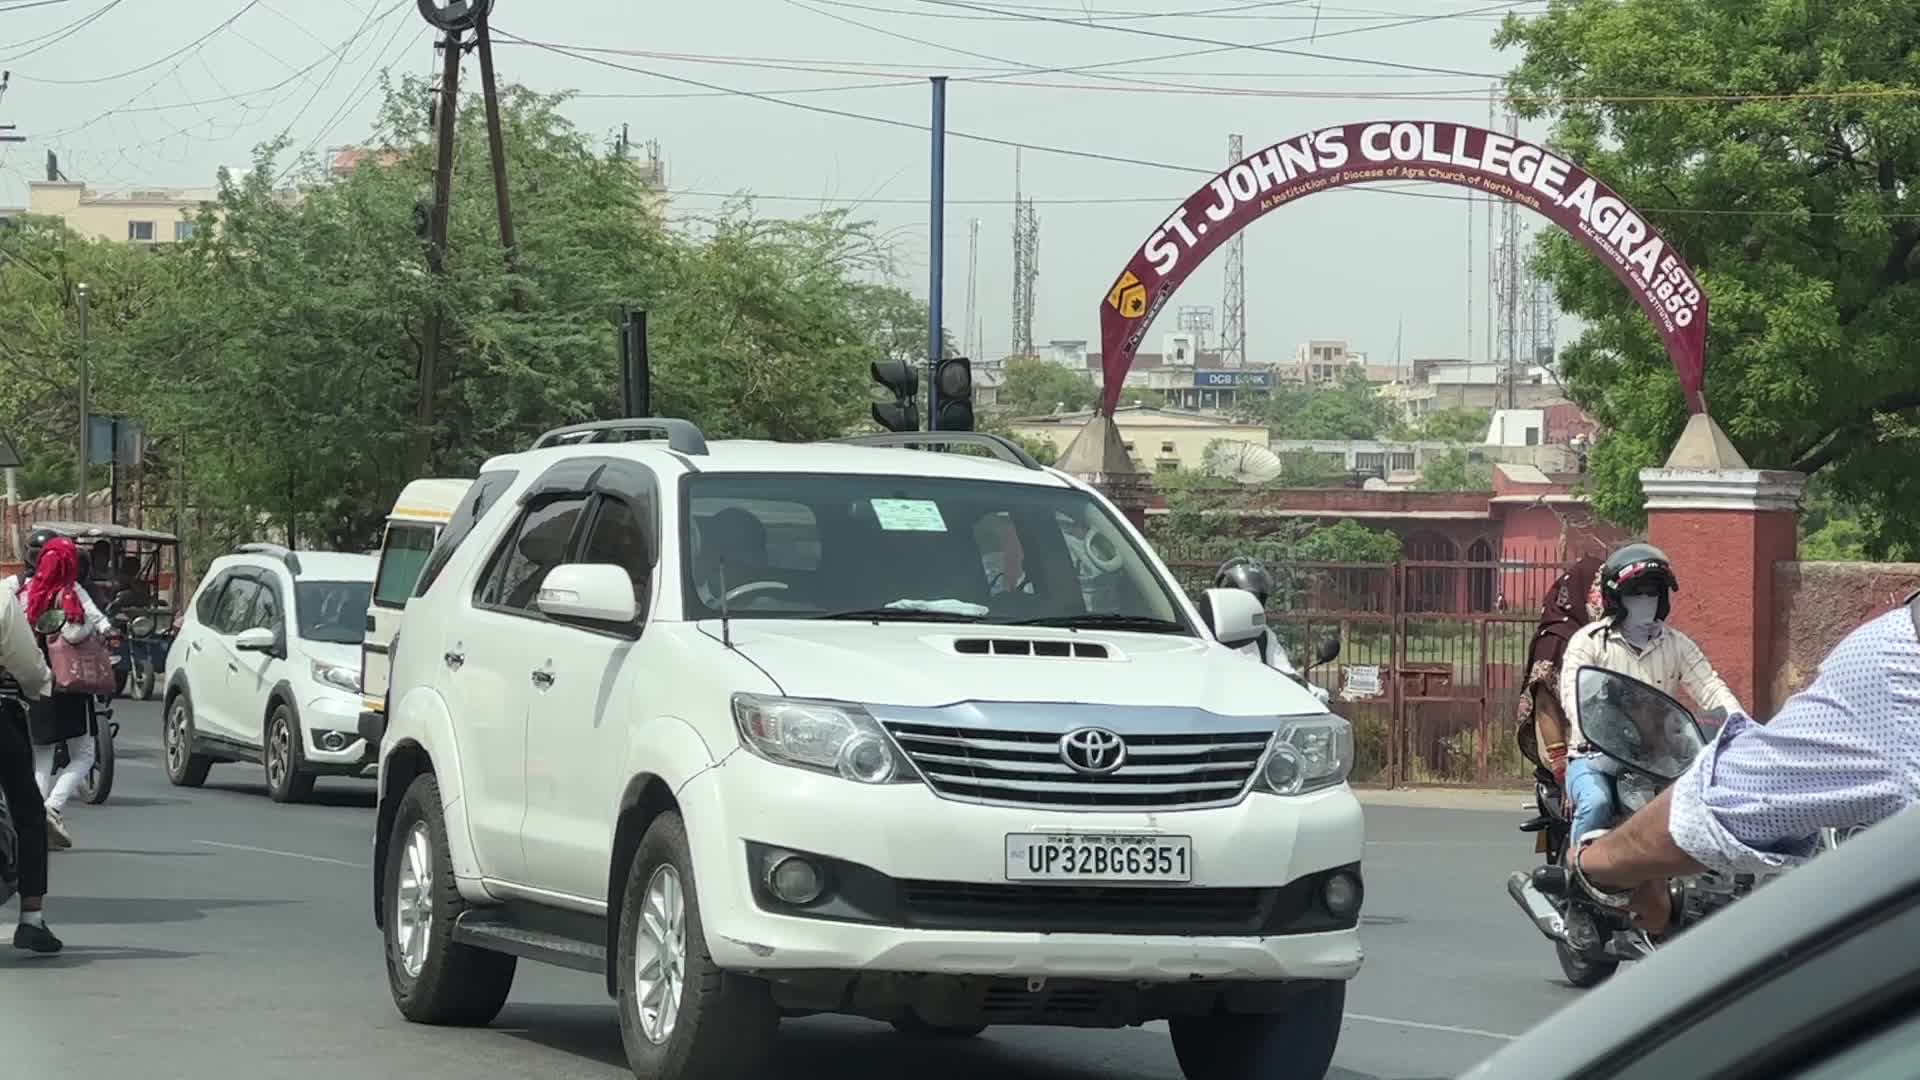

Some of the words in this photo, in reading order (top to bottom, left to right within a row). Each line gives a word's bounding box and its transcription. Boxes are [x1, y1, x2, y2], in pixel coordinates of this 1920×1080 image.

[1144, 207, 1207, 276] ST.
[1205, 128, 1348, 222] JOHN'S
[1562, 177, 1665, 283] AGRA
[1260, 199, 1273, 211] An
[1272, 177, 1328, 204] Institution
[1330, 173, 1340, 183] of
[1343, 169, 1384, 180] Diocese
[1387, 166, 1399, 176] of
[1428, 168, 1467, 182] Church
[1468, 176, 1480, 185] of
[1483, 179, 1513, 197] North
[1651, 273, 1693, 327] 1850
[1028, 845, 1185, 874] UP32BG6351
